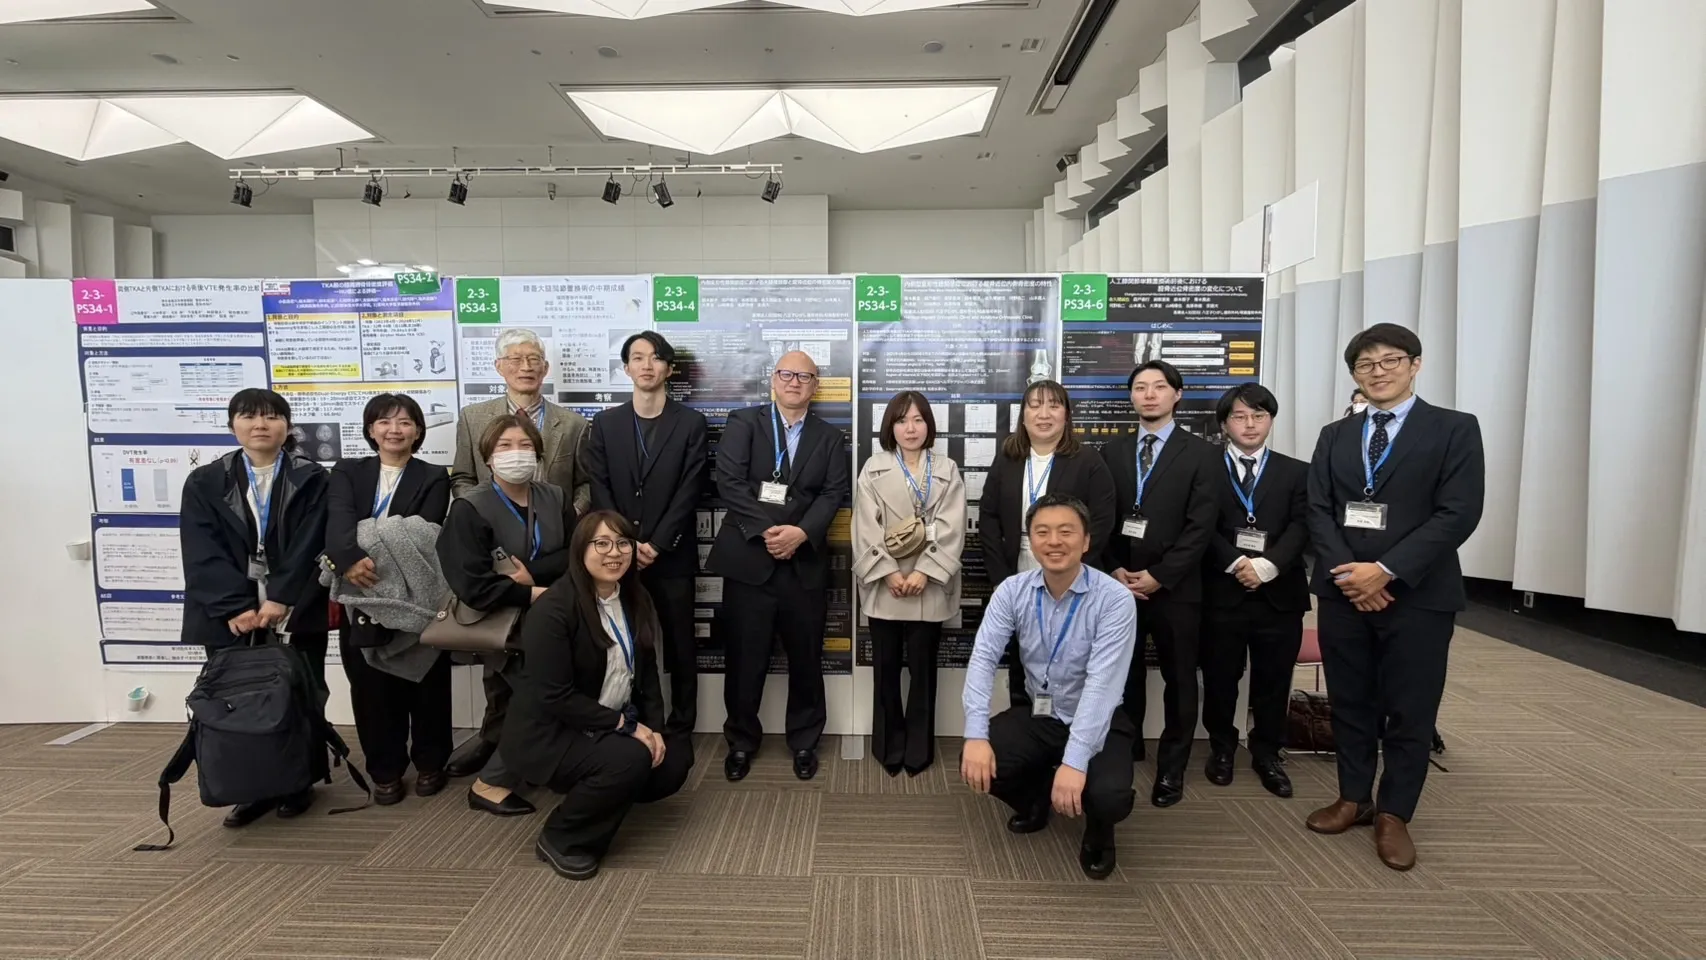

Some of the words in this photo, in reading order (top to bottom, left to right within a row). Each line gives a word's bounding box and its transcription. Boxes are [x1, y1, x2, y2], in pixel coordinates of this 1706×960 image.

[396, 273, 433, 284] PS34-2
[82, 289, 105, 299] 2-3-
[467, 288, 489, 298] 2-3-
[664, 286, 687, 297] 2-3-
[866, 286, 889, 297] 2-3-
[1073, 284, 1096, 294] 2-3-
[76, 304, 113, 314] PS34-1
[460, 303, 498, 313] PS34-3
[656, 301, 695, 312] PS34-4
[858, 301, 897, 311] PS34-5
[1064, 299, 1104, 310] PS34-6
[489, 385, 507, 393] 対象
[594, 393, 612, 401] 考察
